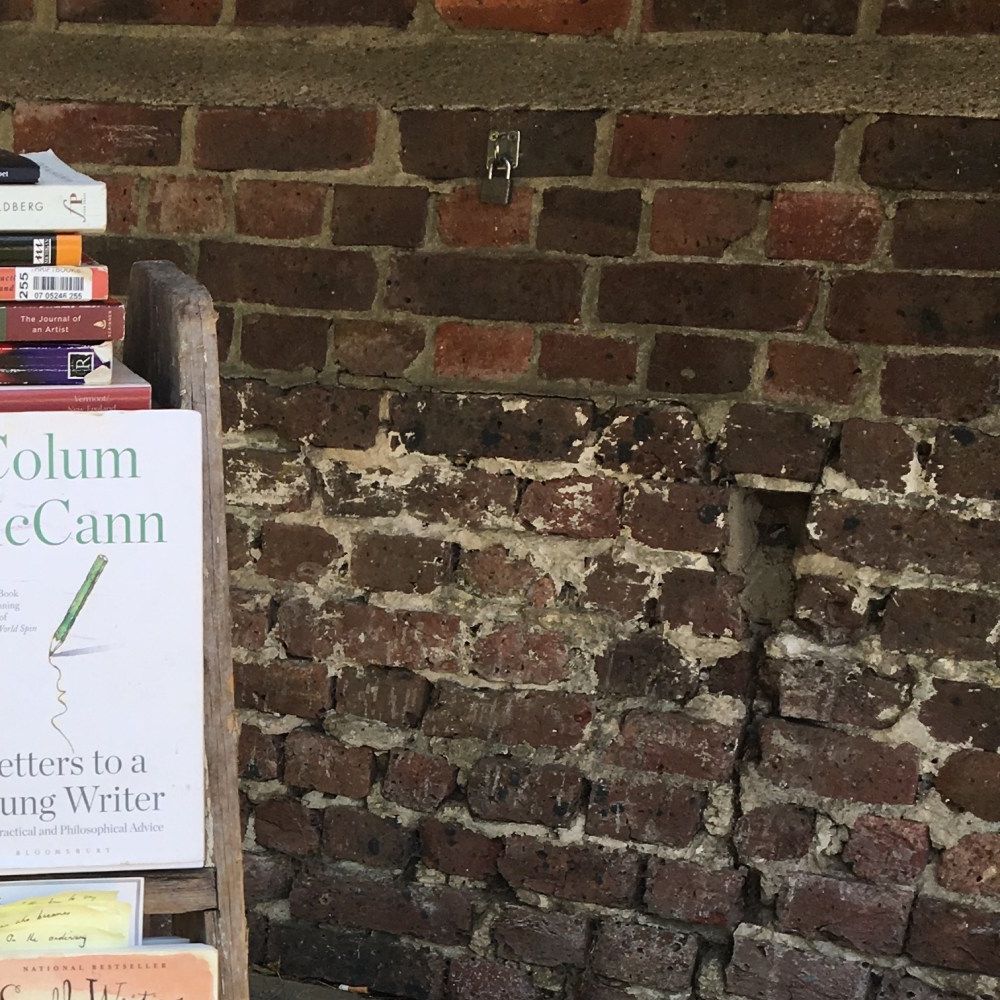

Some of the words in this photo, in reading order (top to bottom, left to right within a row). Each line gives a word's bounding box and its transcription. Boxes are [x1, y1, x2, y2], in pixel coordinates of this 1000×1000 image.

[20, 272, 29, 299] 255
[39, 315, 70, 323] Journal
[72, 315, 82, 323] of
[0, 612, 9, 622] of
[20, 624, 37, 635] Spin
[92, 750, 123, 775] to
[130, 754, 148, 774] a
[64, 785, 166, 814] Writer
[39, 826, 58, 837] and
[60, 823, 128, 837] Philosophical
[130, 823, 165, 834] Advice
[16, 848, 111, 857] BLOOMSBURY
[22, 964, 84, 973] NATIONAL
[92, 962, 168, 971] BESTSELLER
